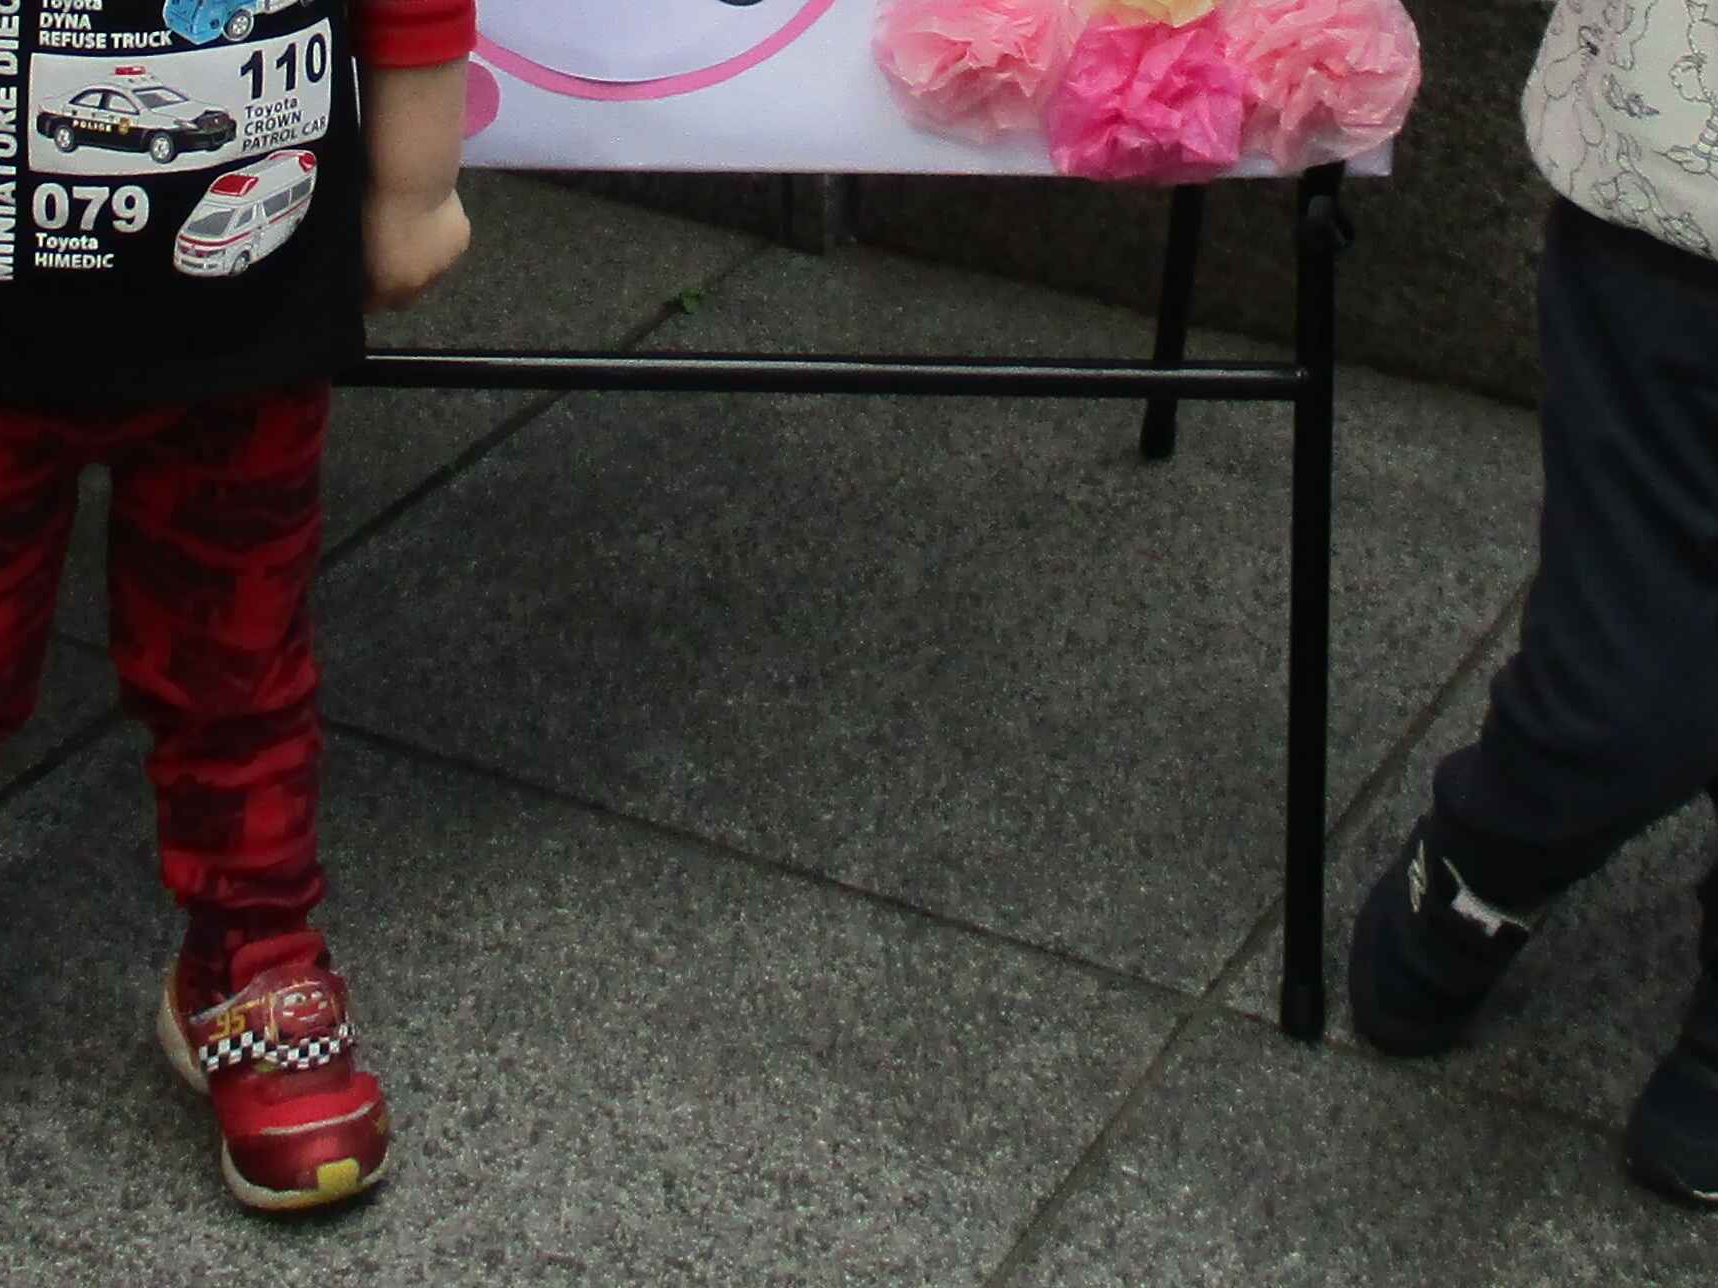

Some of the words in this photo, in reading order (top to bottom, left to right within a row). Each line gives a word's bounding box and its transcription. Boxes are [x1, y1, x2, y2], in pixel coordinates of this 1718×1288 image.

[39, 12, 92, 31] DYNA
[38, 29, 108, 50] REFUSE
[110, 30, 173, 50] TRUCK
[239, 32, 328, 101] 110
[244, 97, 299, 120] Toyota
[71, 119, 113, 133] POLICE
[241, 127, 299, 154] PATROL
[301, 115, 328, 138] CAR
[243, 110, 303, 138] CROWN
[32, 181, 150, 234] 079
[34, 231, 99, 252] Toyota
[34, 251, 115, 270] HIMEDIC
